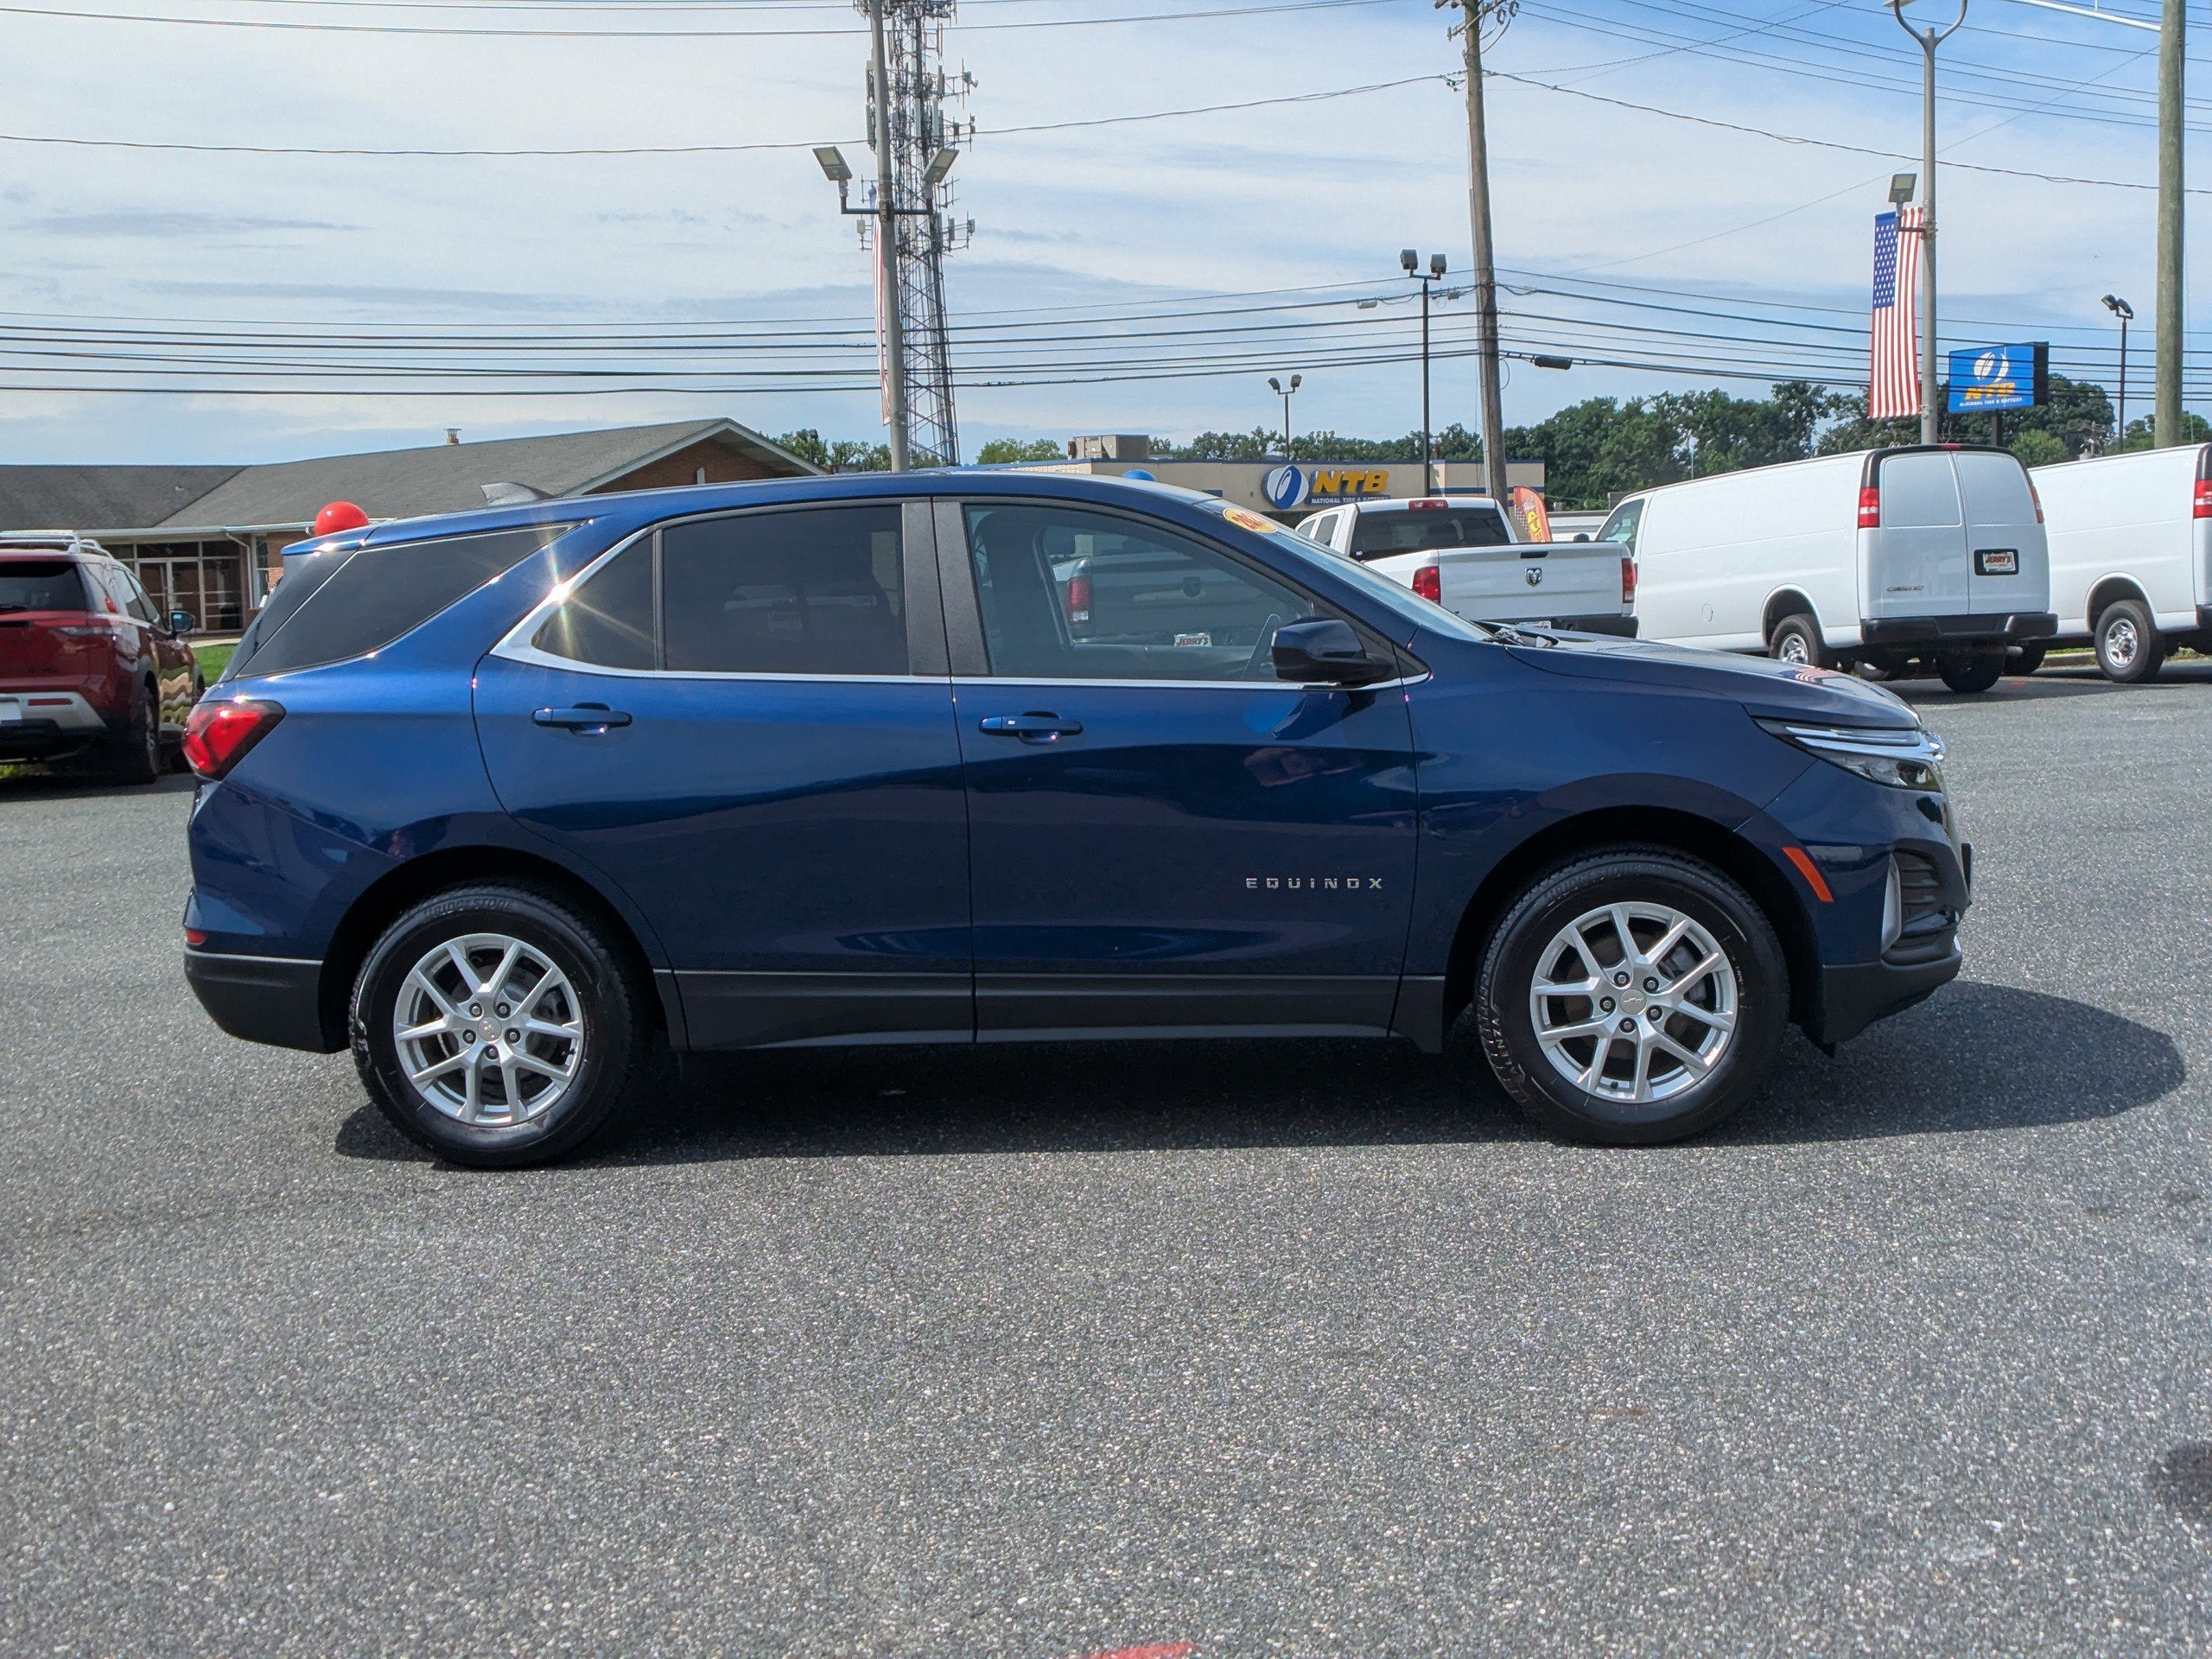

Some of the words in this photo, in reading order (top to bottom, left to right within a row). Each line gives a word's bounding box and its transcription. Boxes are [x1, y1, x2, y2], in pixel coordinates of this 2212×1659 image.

[1965, 382, 2015, 400] NTB
[1313, 470, 1389, 493] NTB
[1177, 637, 1209, 646] JERRY'S
[1245, 877, 1382, 889] EQUINOX
